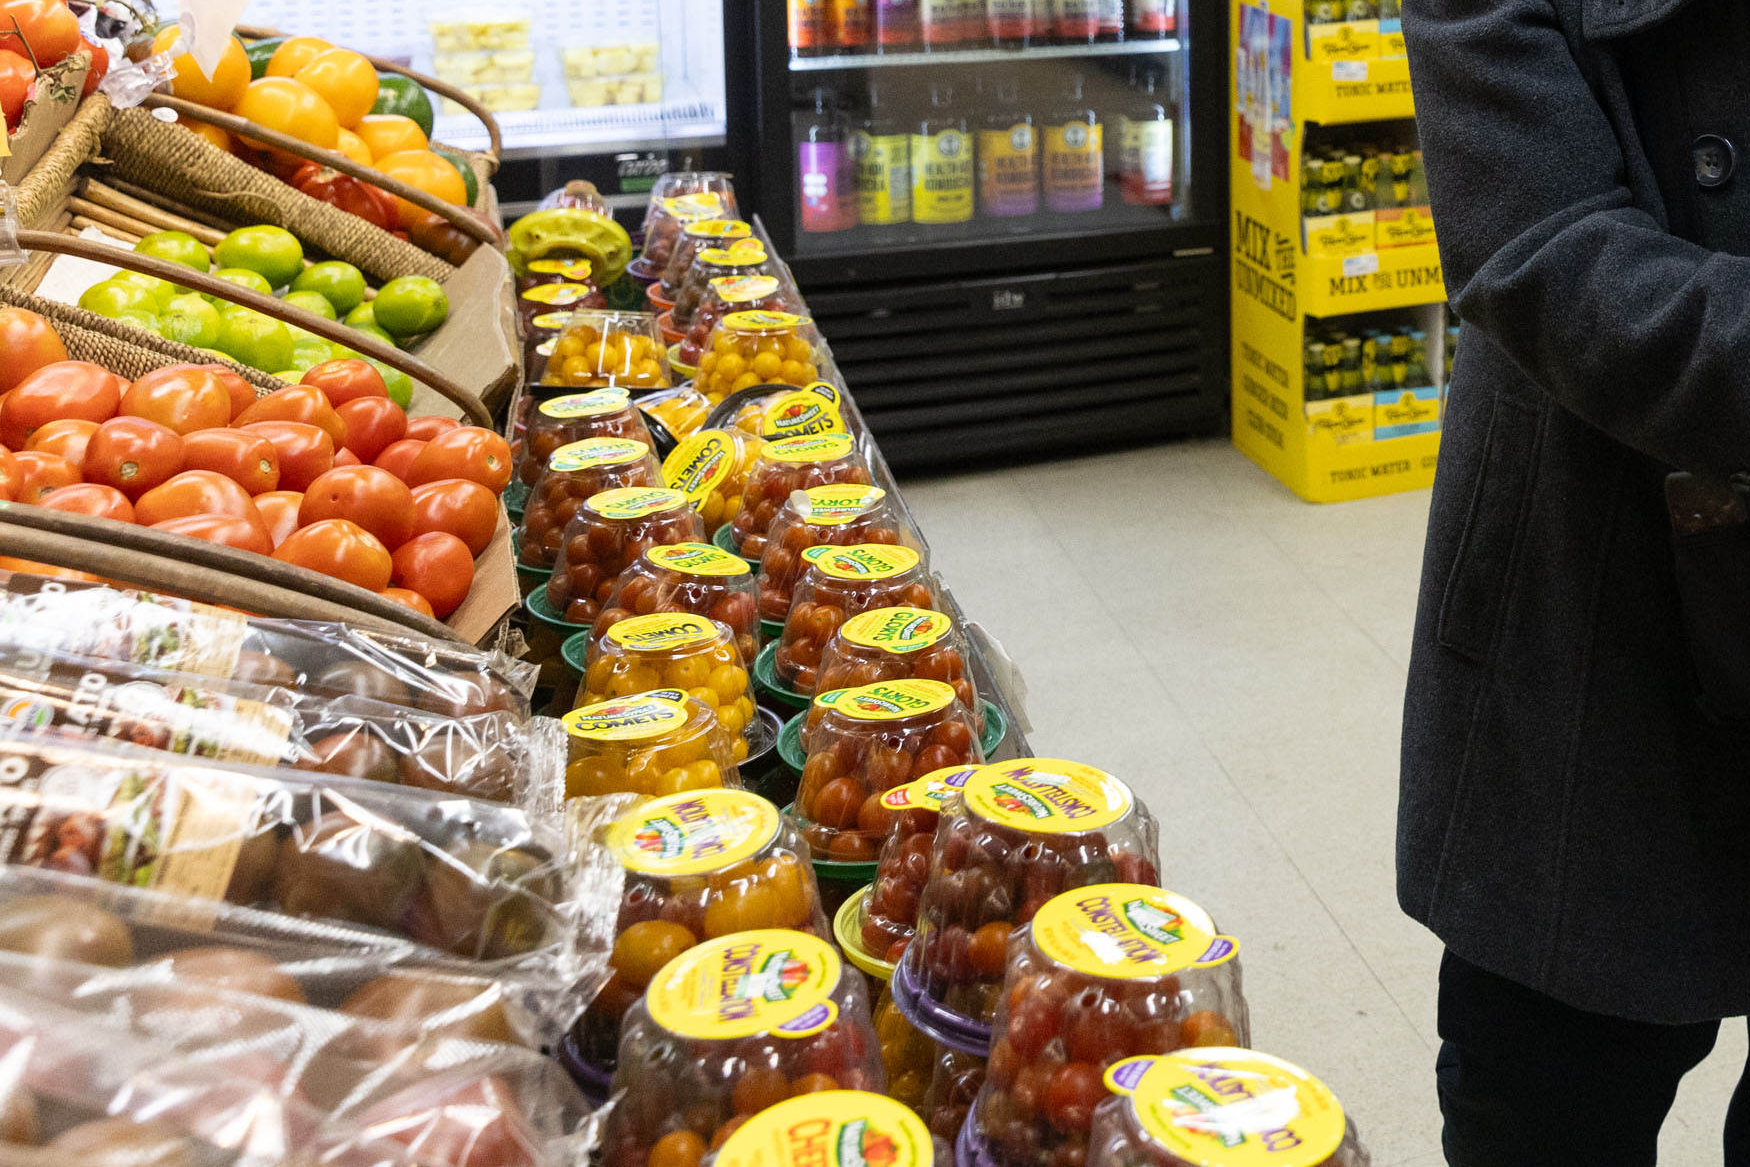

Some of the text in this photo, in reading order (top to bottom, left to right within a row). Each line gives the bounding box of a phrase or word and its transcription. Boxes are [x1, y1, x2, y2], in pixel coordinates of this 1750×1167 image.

[1236, 209, 1271, 271] MIX
[1329, 274, 1367, 297] MIX
[774, 442, 840, 456] GLORYS
[847, 548, 895, 573] GLORYS
[623, 623, 704, 643] COMETS
[872, 611, 915, 642] GLORYS
[868, 686, 930, 709] GLORYS
[574, 710, 676, 731] COMETS
